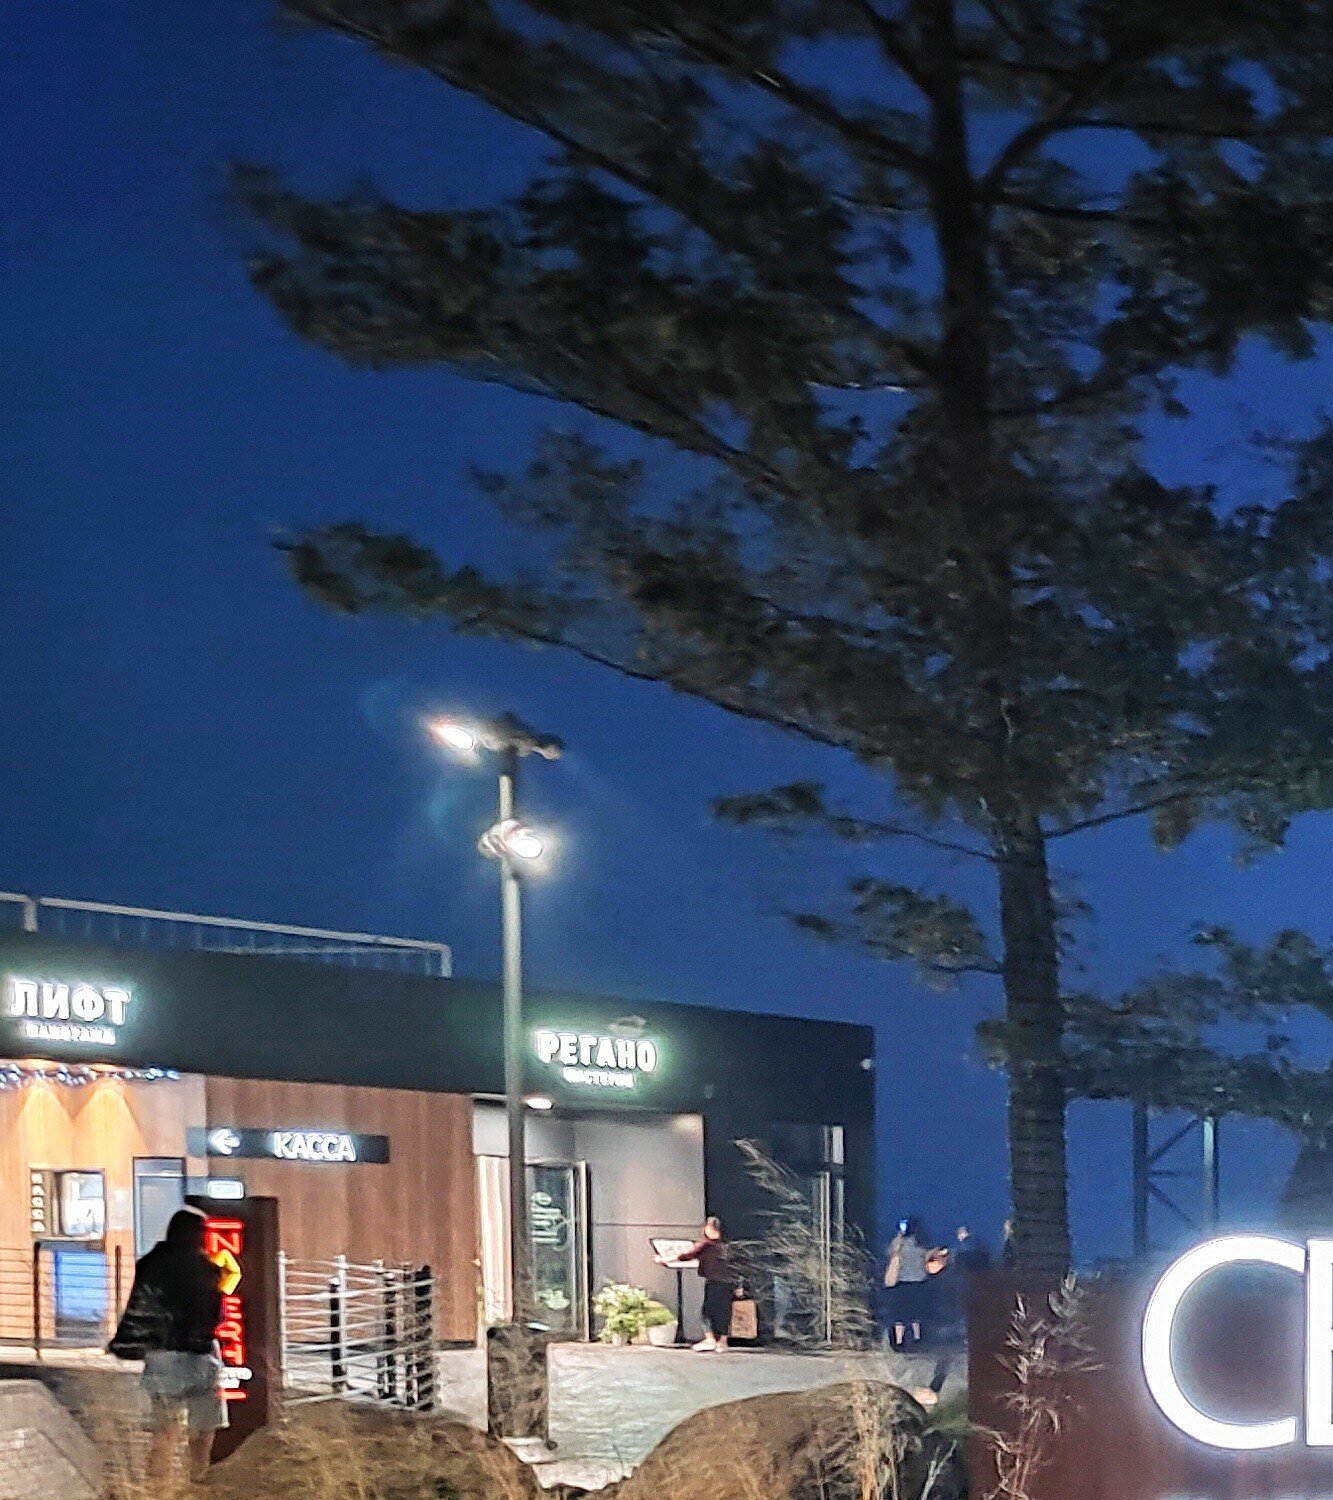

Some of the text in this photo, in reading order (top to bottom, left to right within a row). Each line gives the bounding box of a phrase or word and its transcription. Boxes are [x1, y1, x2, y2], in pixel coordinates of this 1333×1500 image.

[10, 980, 131, 1026] ЛИФТ
[537, 1029, 657, 1072] РЕГАНО
[272, 1130, 357, 1162] КАССА
